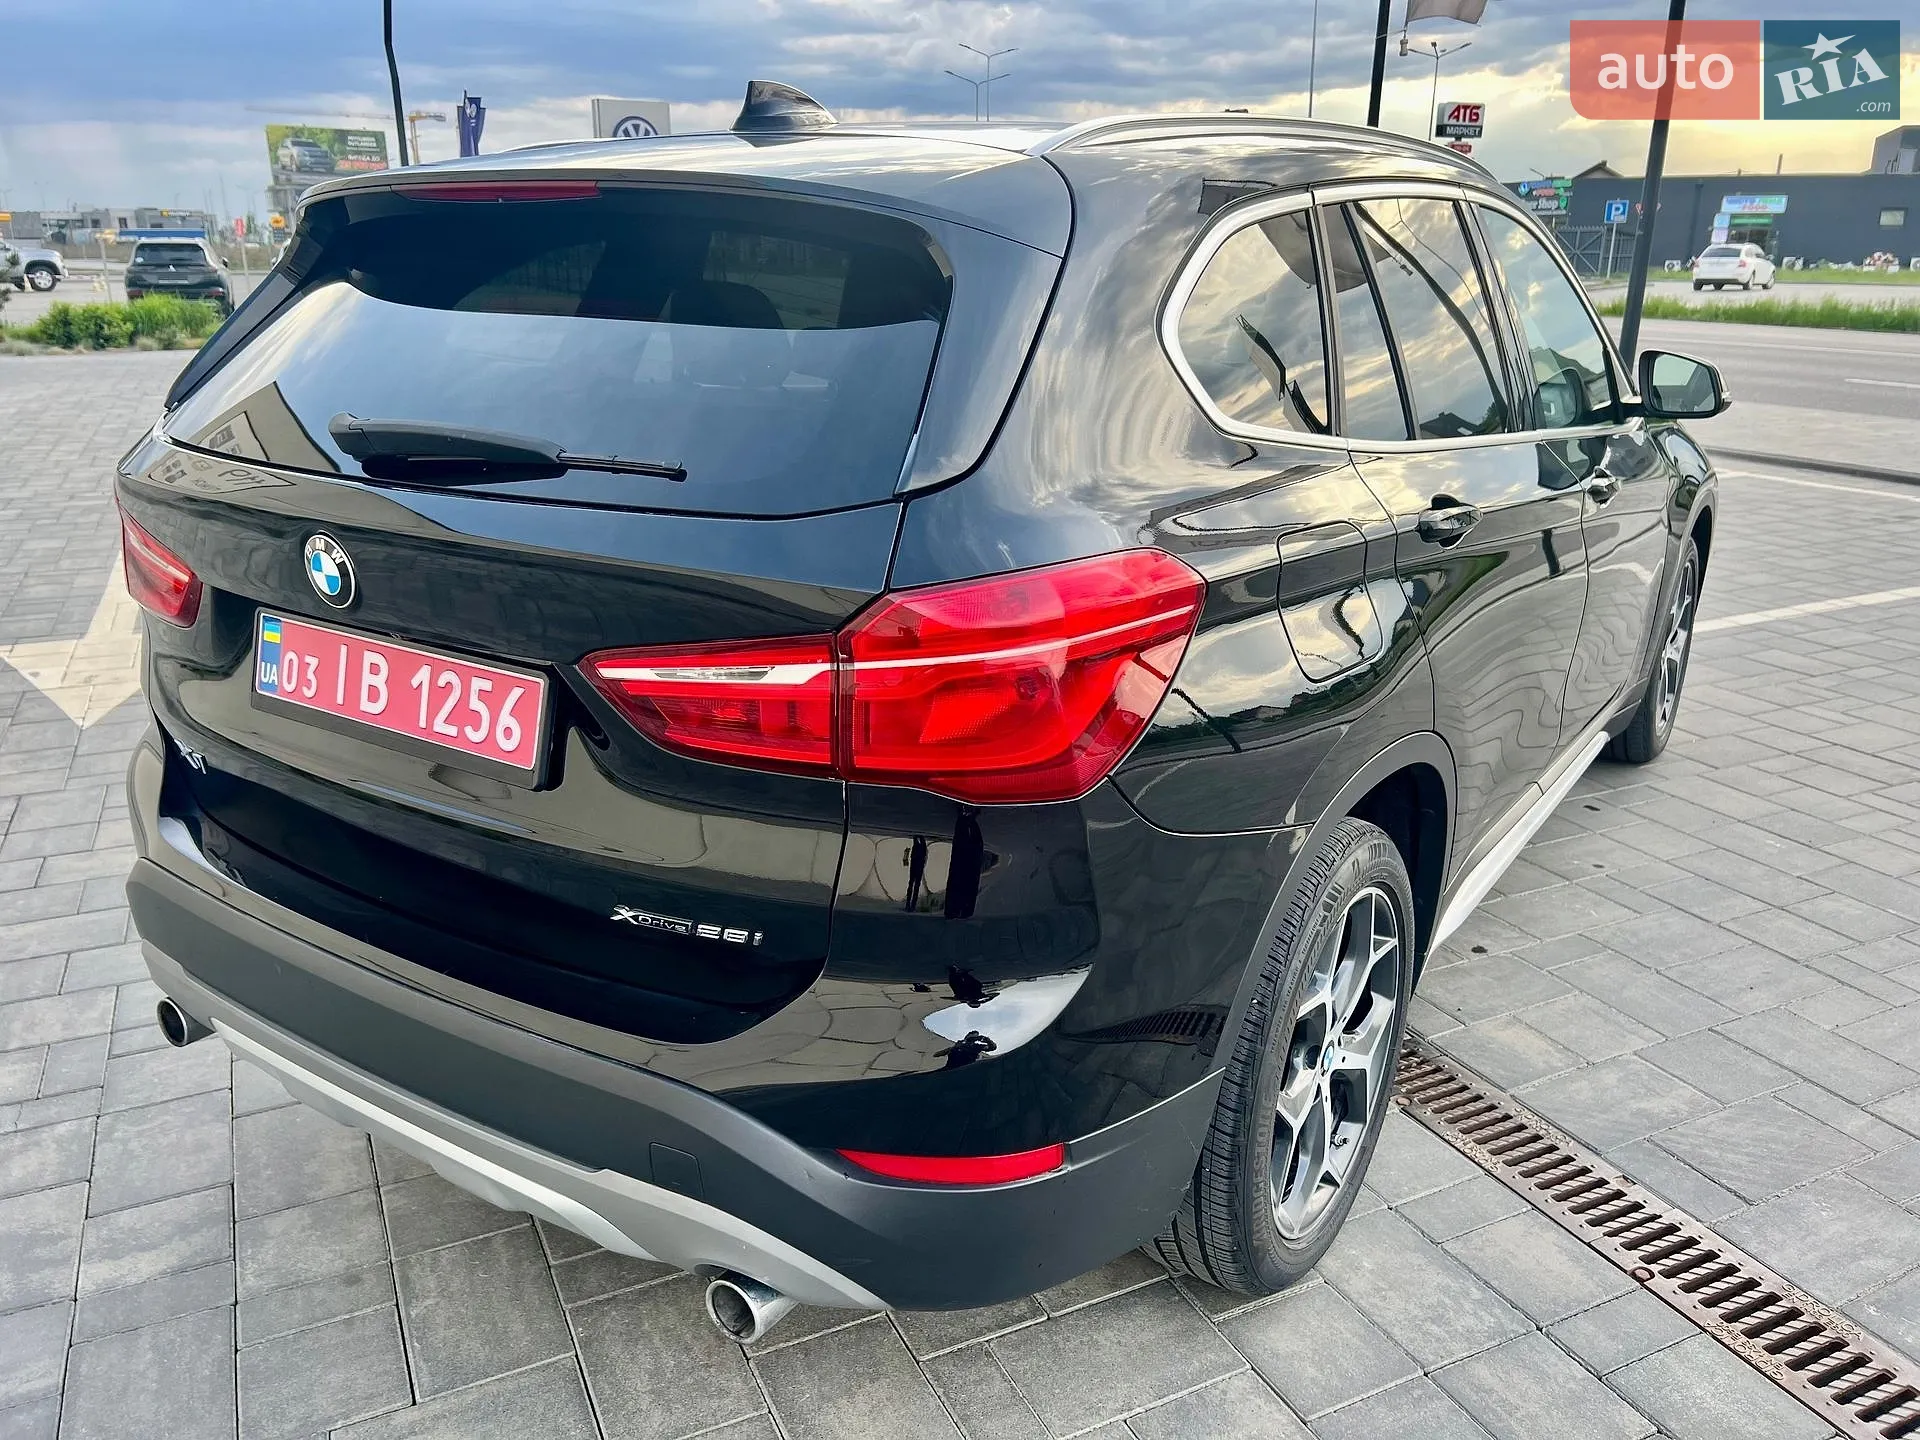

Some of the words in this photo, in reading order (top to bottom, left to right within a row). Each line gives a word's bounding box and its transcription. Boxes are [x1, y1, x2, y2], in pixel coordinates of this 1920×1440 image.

[1446, 126, 1481, 136] МАРКЕТ
[1610, 203, 1624, 221] P
[305, 537, 345, 565] BMW
[260, 661, 278, 686] UA
[282, 650, 320, 699] 03
[411, 663, 525, 752] 1256
[1781, 1283, 1862, 1341] GIDROLICA
[1703, 1320, 1785, 1381] GIDROLICA
